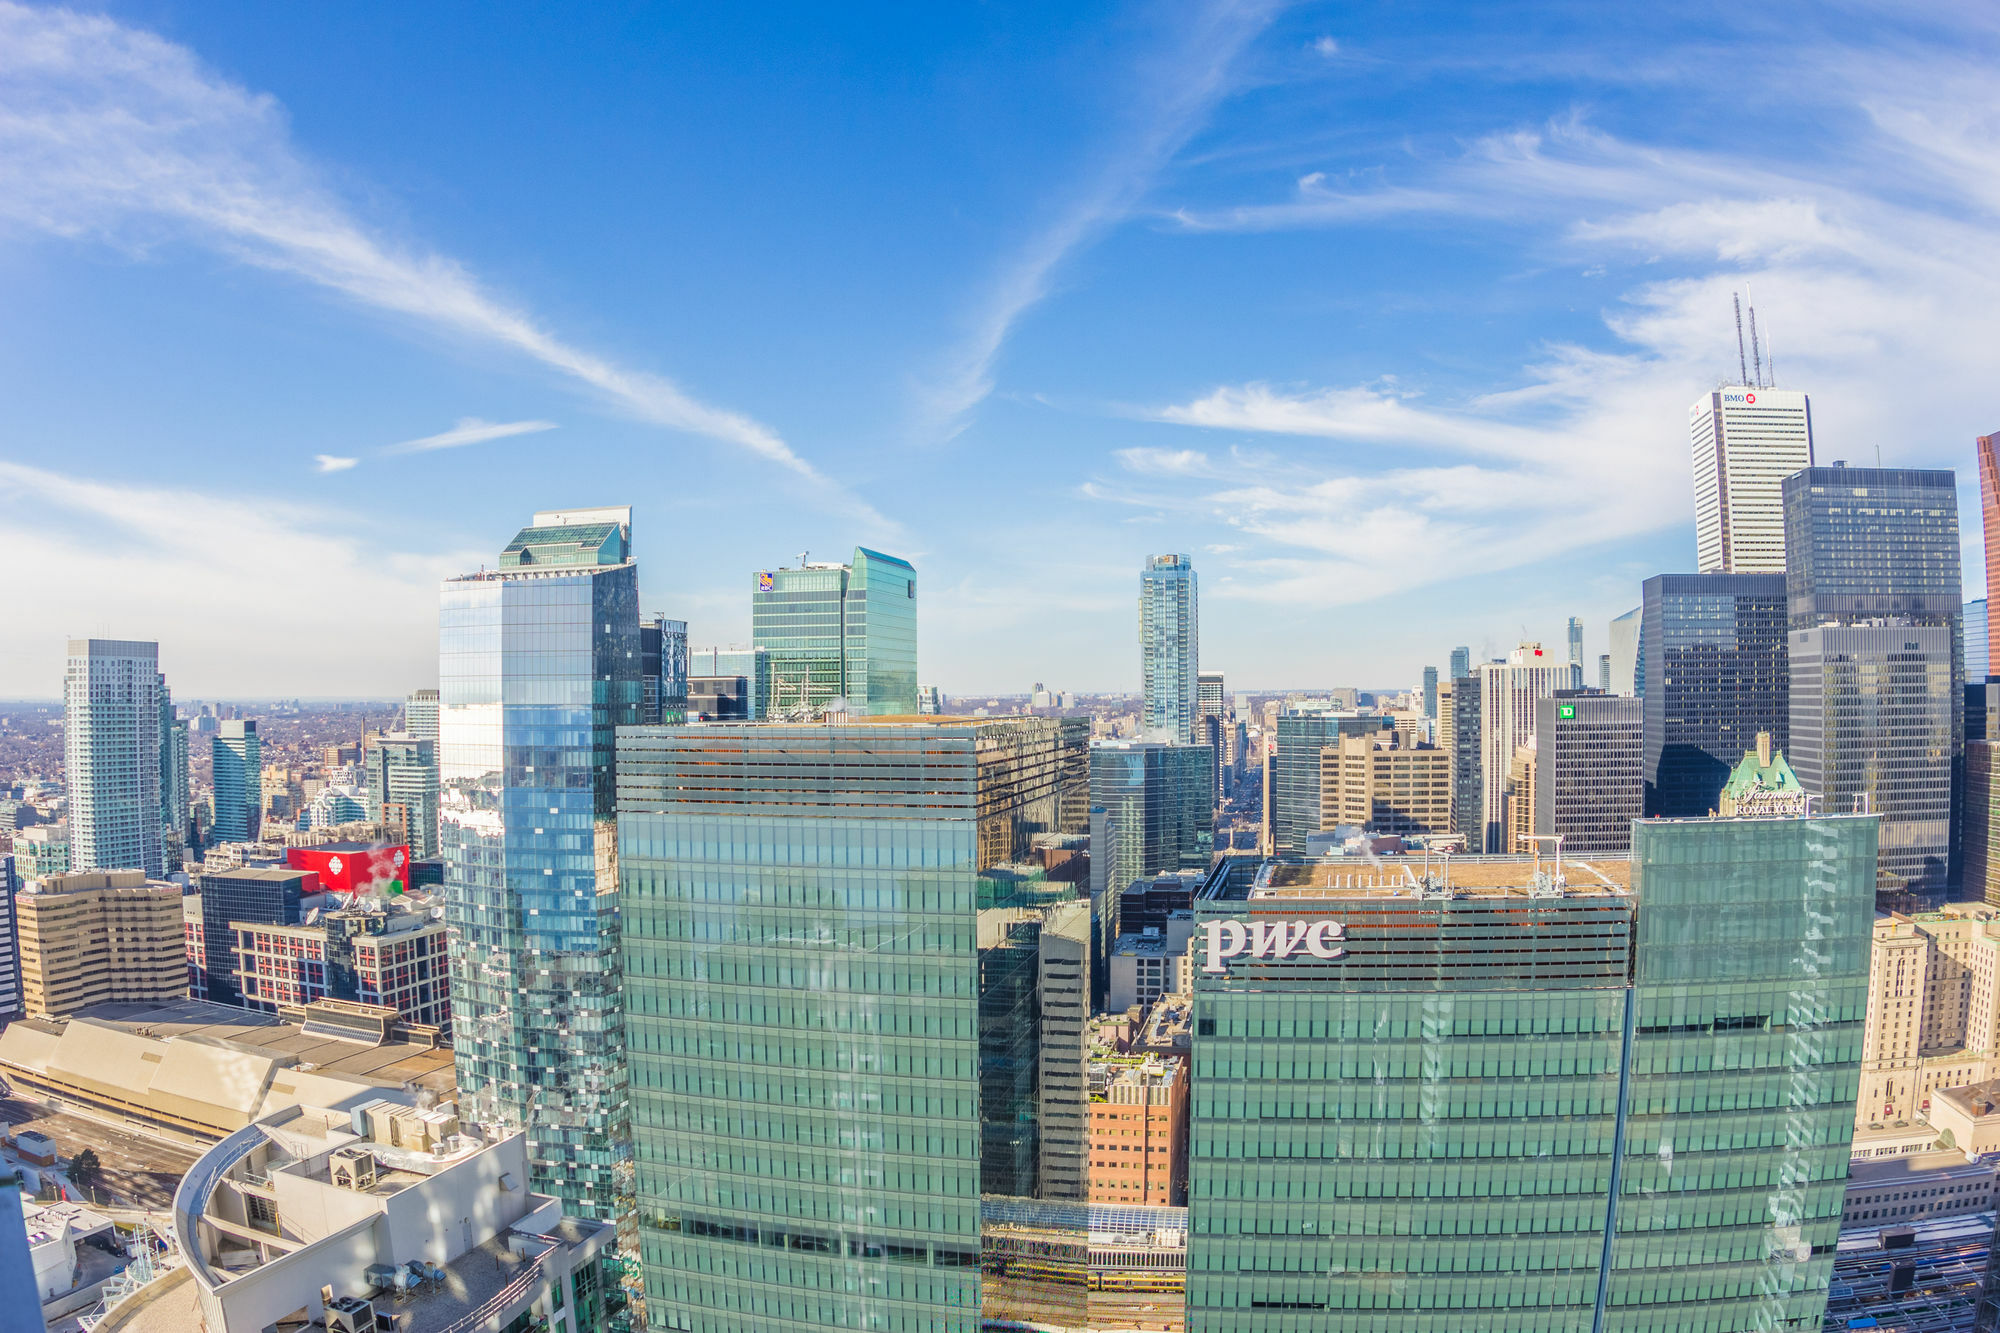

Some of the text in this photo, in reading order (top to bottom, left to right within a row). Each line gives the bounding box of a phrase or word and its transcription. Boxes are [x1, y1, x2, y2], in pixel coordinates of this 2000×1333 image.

[1724, 394, 1744, 402] BMO
[1561, 707, 1573, 715] TD
[1736, 780, 1804, 804] Fairmont
[1736, 803, 1804, 815] ROYAL YORK
[1200, 919, 1343, 972] pwc
